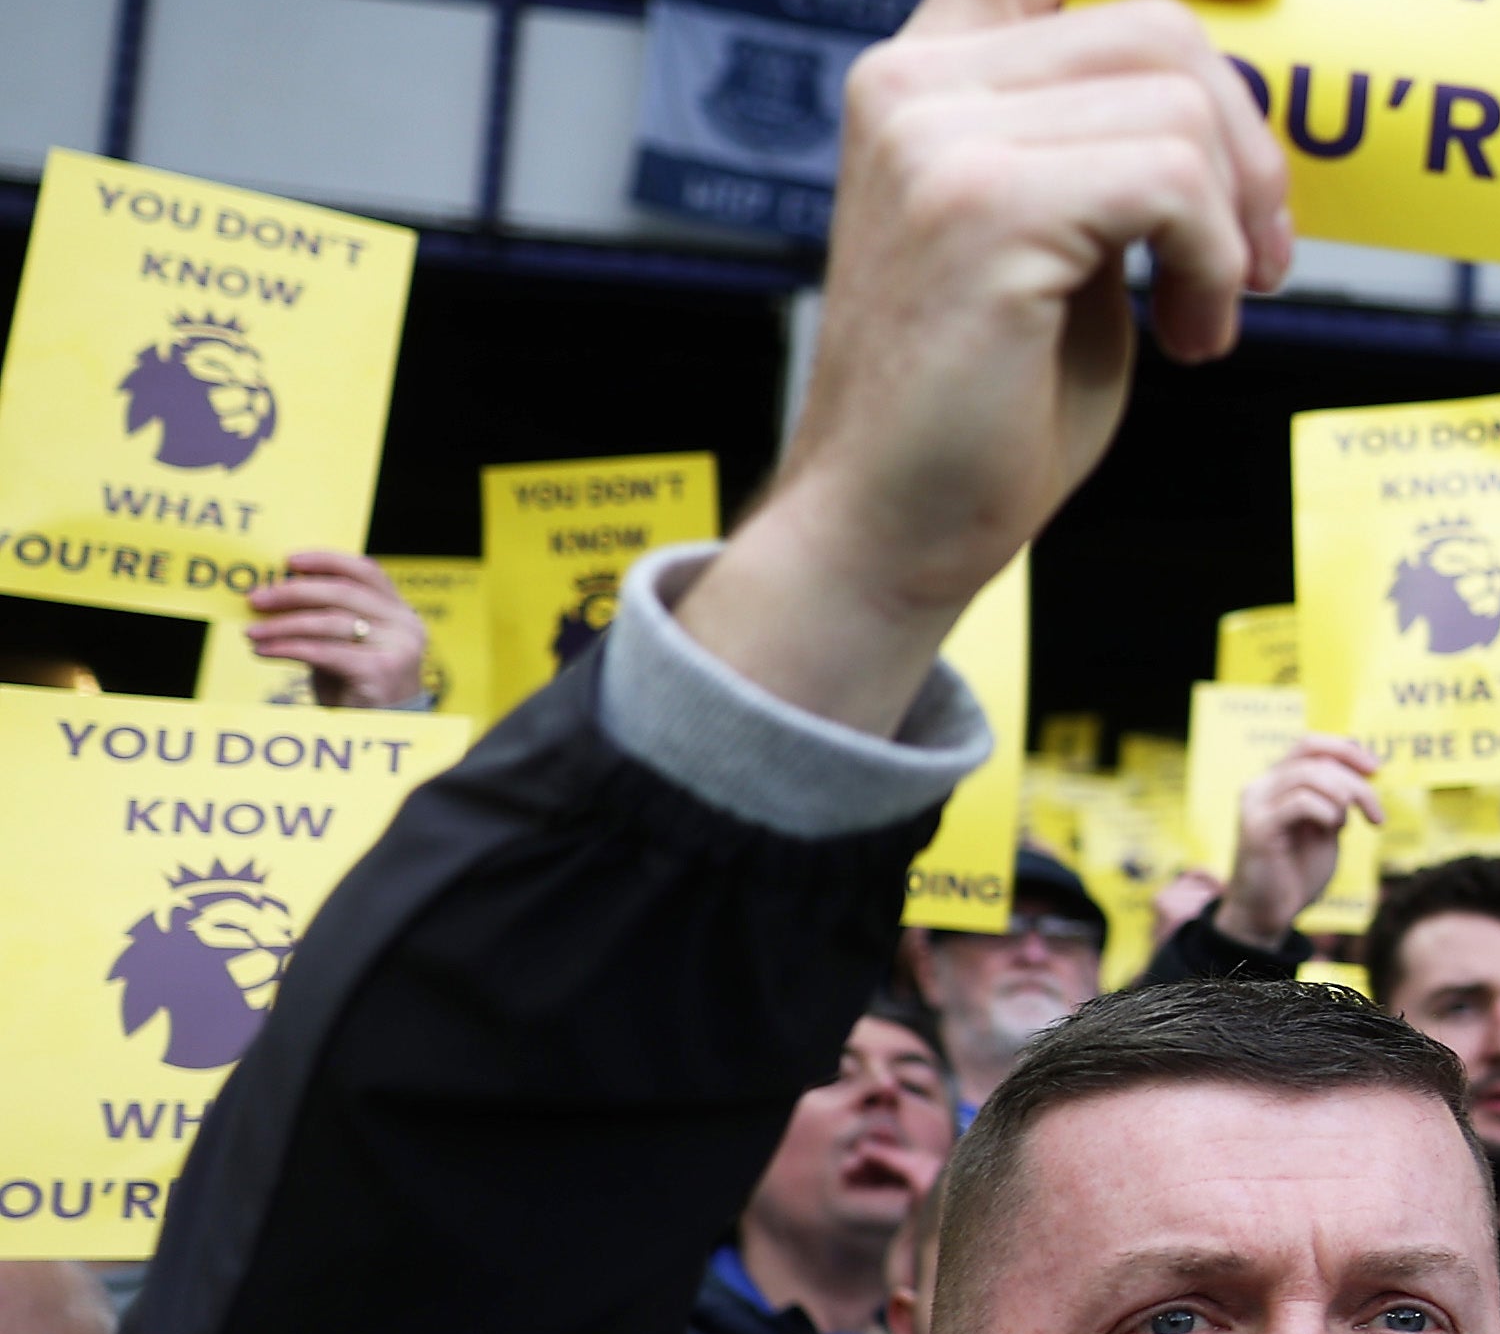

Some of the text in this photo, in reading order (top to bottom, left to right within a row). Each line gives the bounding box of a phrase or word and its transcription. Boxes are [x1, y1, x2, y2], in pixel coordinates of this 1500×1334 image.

[96, 181, 368, 267] YOU DON'T
[140, 249, 304, 307] KNOW
[1335, 423, 1419, 456] YOU
[102, 482, 260, 532] WHAT
[511, 473, 688, 511] YOU DON'T
[57, 721, 414, 774] YOU DON'T
[125, 798, 336, 837] KNOW
